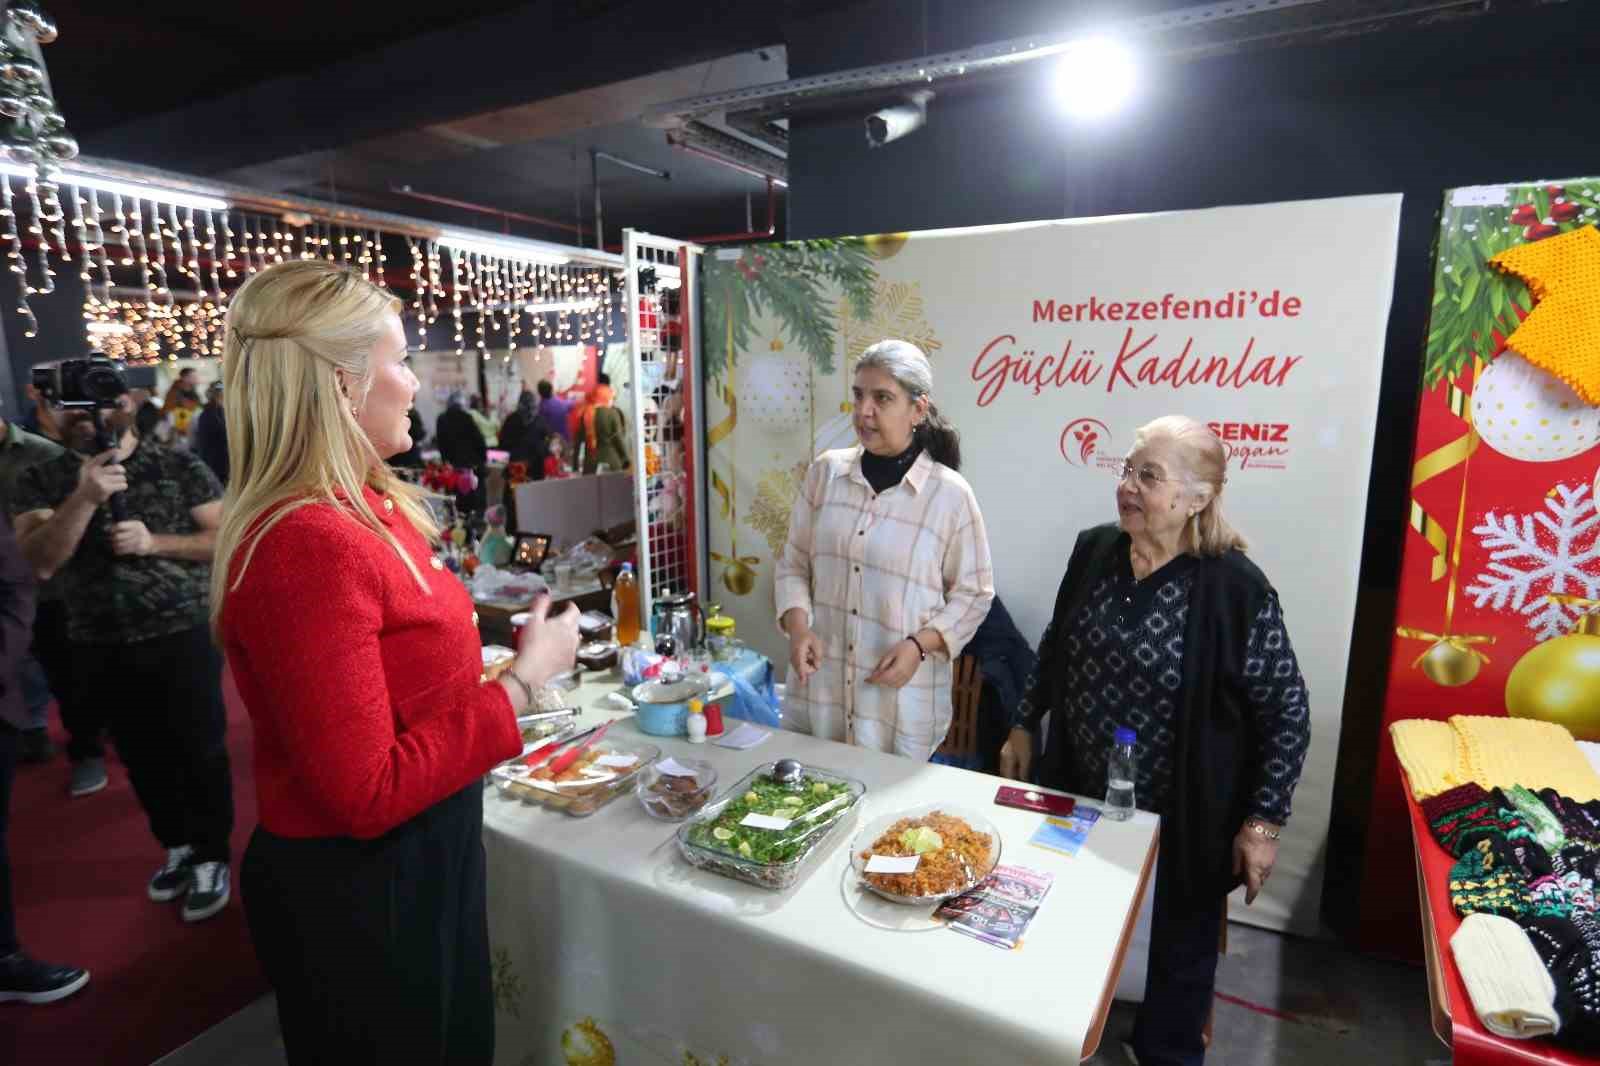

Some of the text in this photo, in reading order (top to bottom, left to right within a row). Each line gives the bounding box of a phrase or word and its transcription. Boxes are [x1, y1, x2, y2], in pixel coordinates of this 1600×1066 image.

[1032, 290, 1302, 322] Merkezefendi’de
[971, 327, 1303, 407] Güçlü Kadınlar
